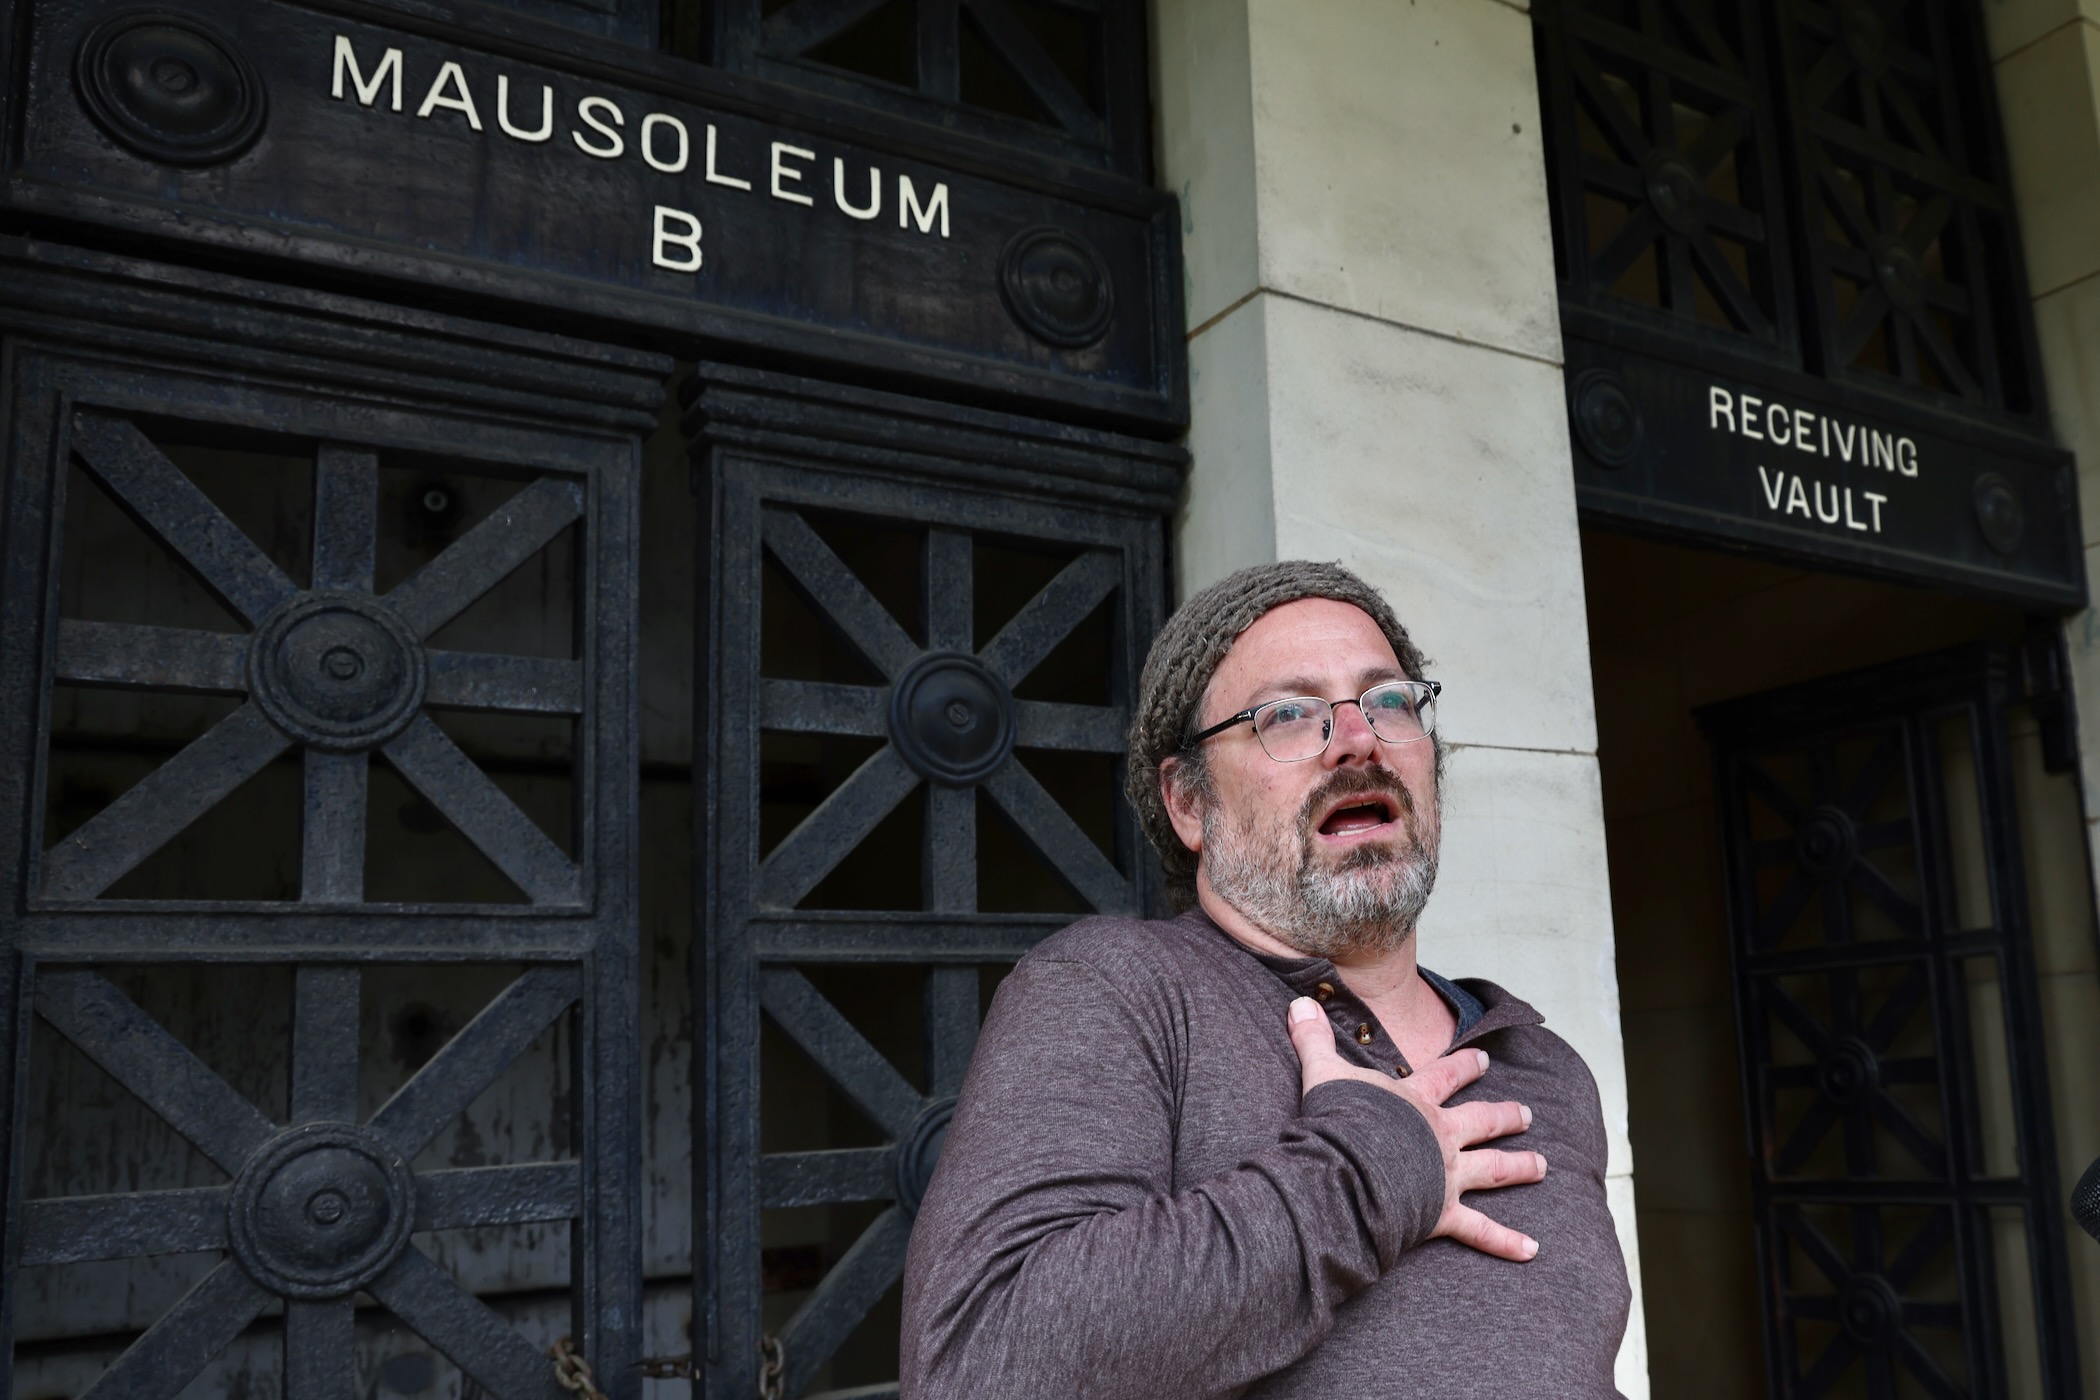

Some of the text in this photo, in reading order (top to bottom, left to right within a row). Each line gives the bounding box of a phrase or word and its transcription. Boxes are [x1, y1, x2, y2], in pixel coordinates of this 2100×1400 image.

[330, 34, 951, 239] MAUSOLEUM
[651, 204, 703, 273] B
[1709, 385, 1919, 478] RECEIVING
[1758, 465, 1888, 533] VAULT
